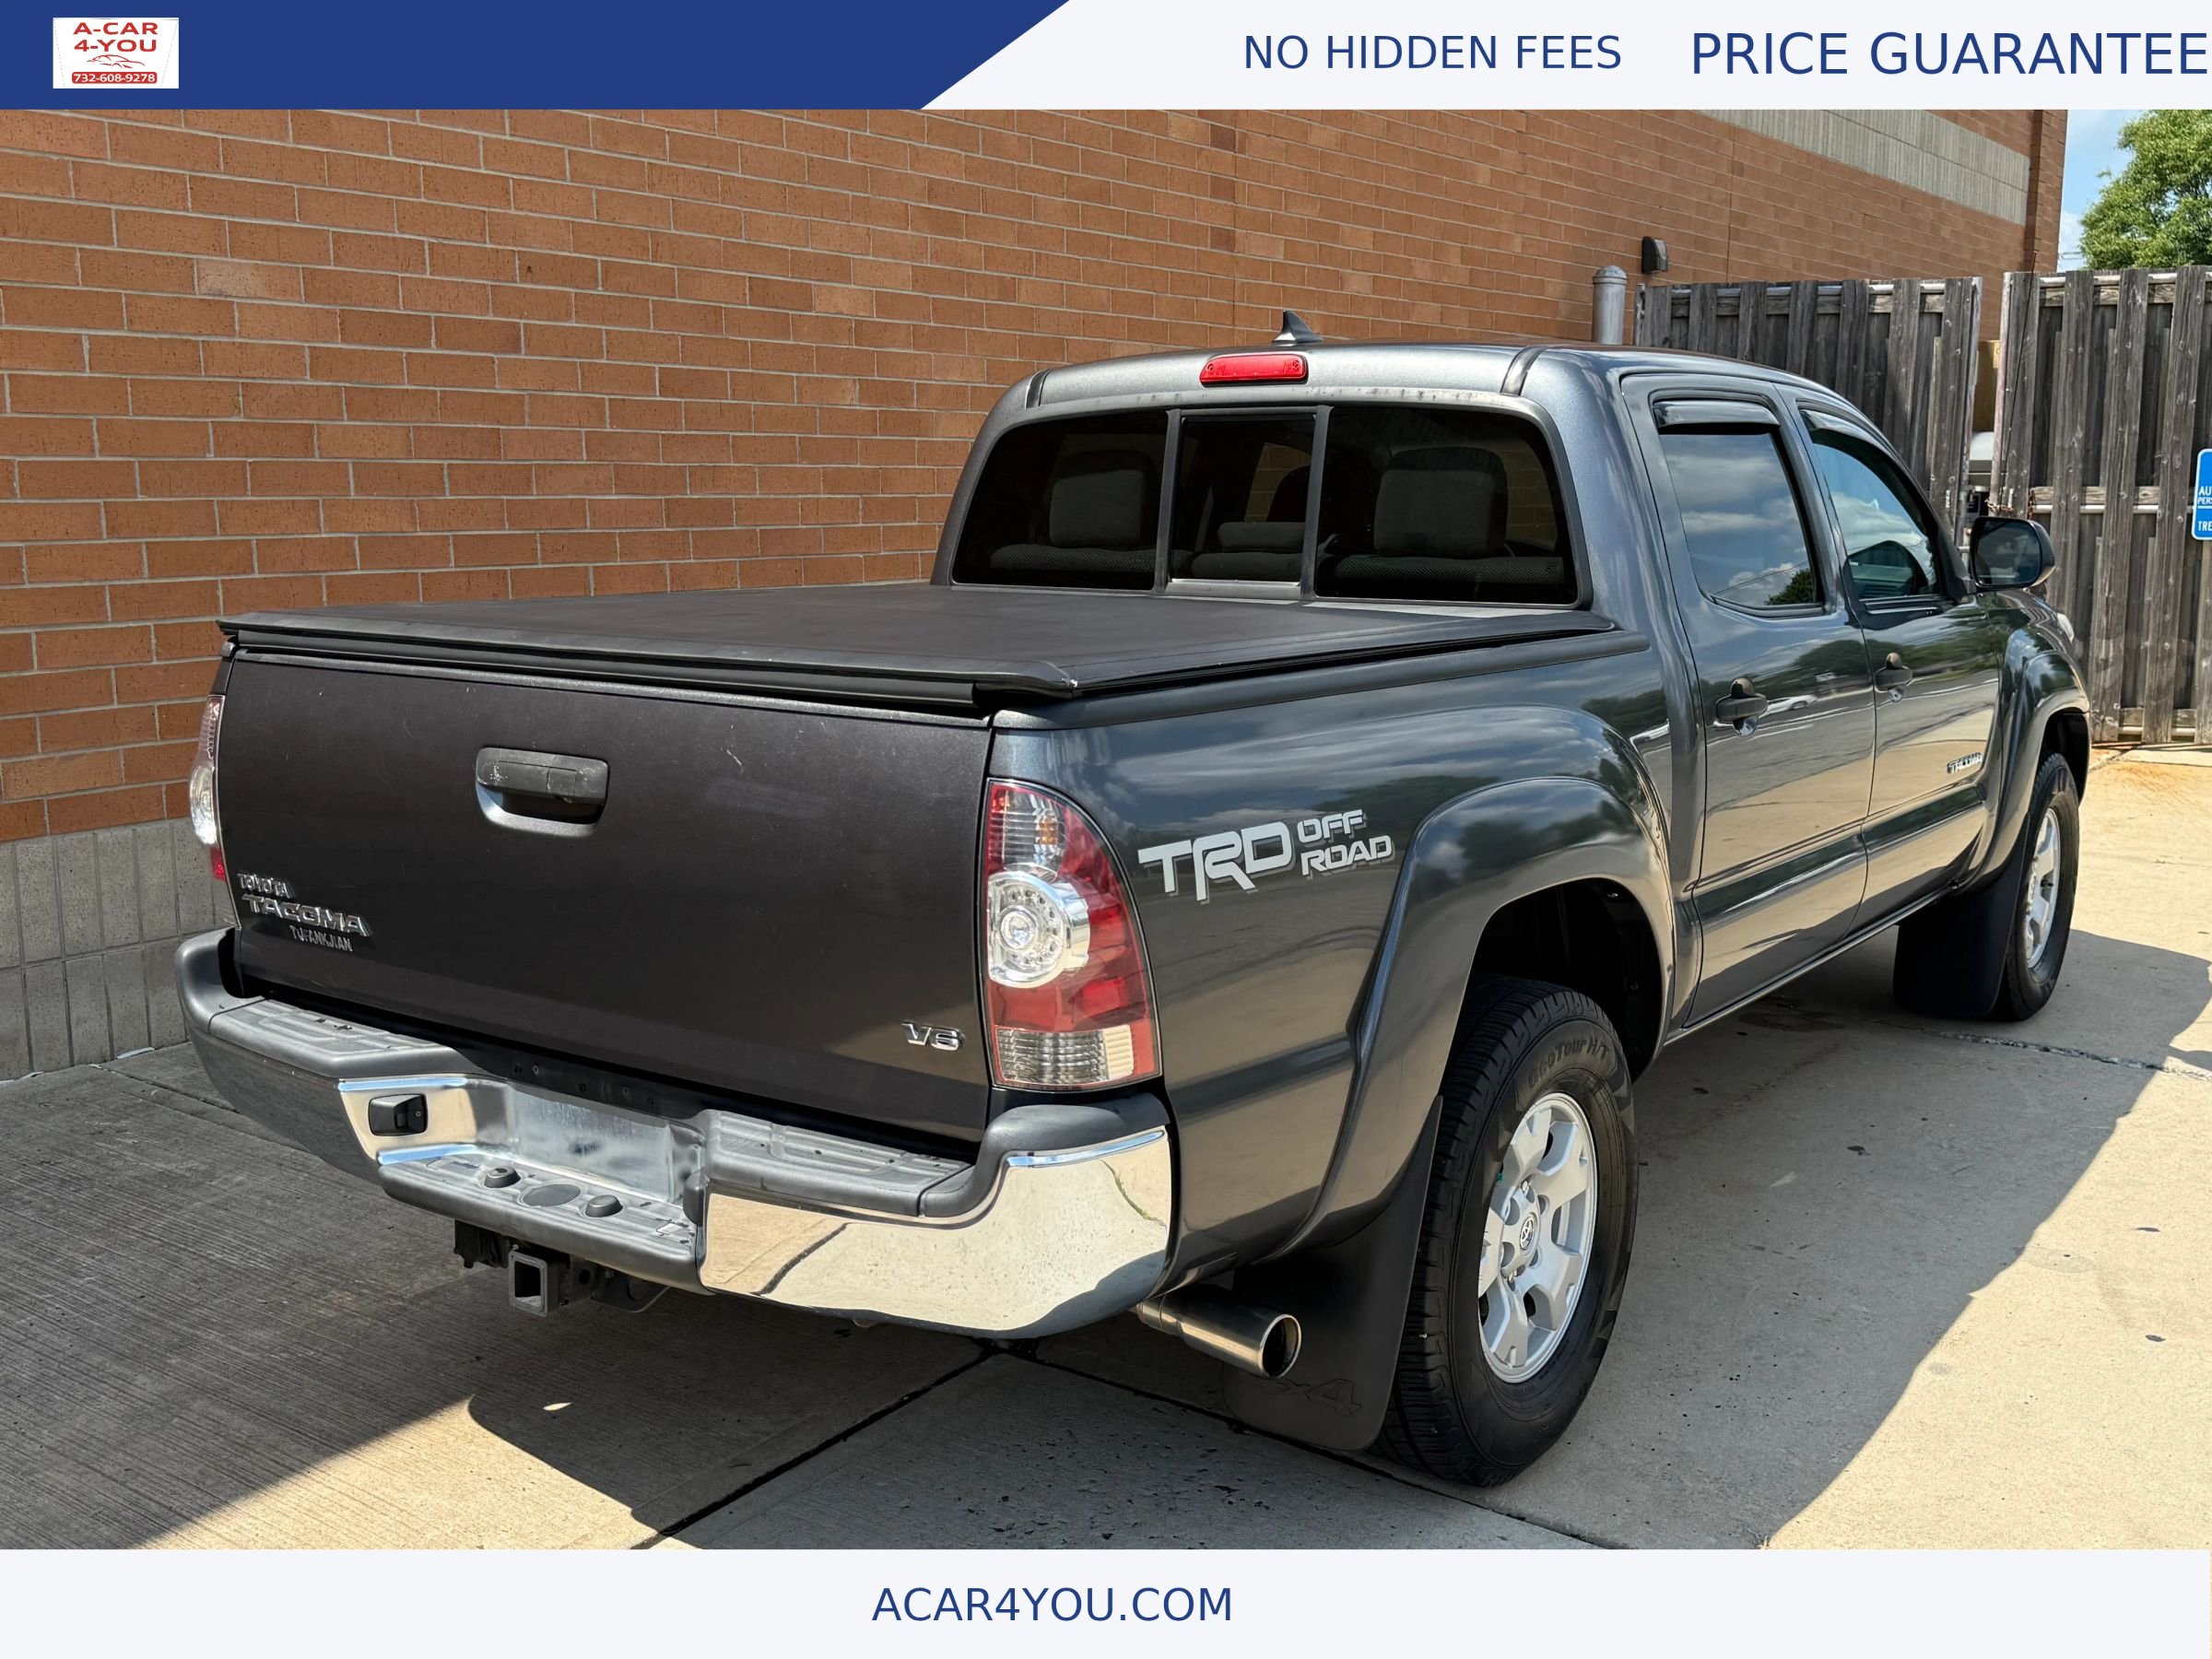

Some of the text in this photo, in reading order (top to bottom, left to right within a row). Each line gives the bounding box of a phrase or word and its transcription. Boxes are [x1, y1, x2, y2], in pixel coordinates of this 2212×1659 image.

[1298, 809, 1365, 844] OFF
[1137, 821, 1293, 903] TRD
[1300, 835, 1394, 877] ROAD
[237, 873, 292, 900] TOYOTA
[241, 893, 372, 937] TACOMA
[901, 1021, 962, 1051] V6
